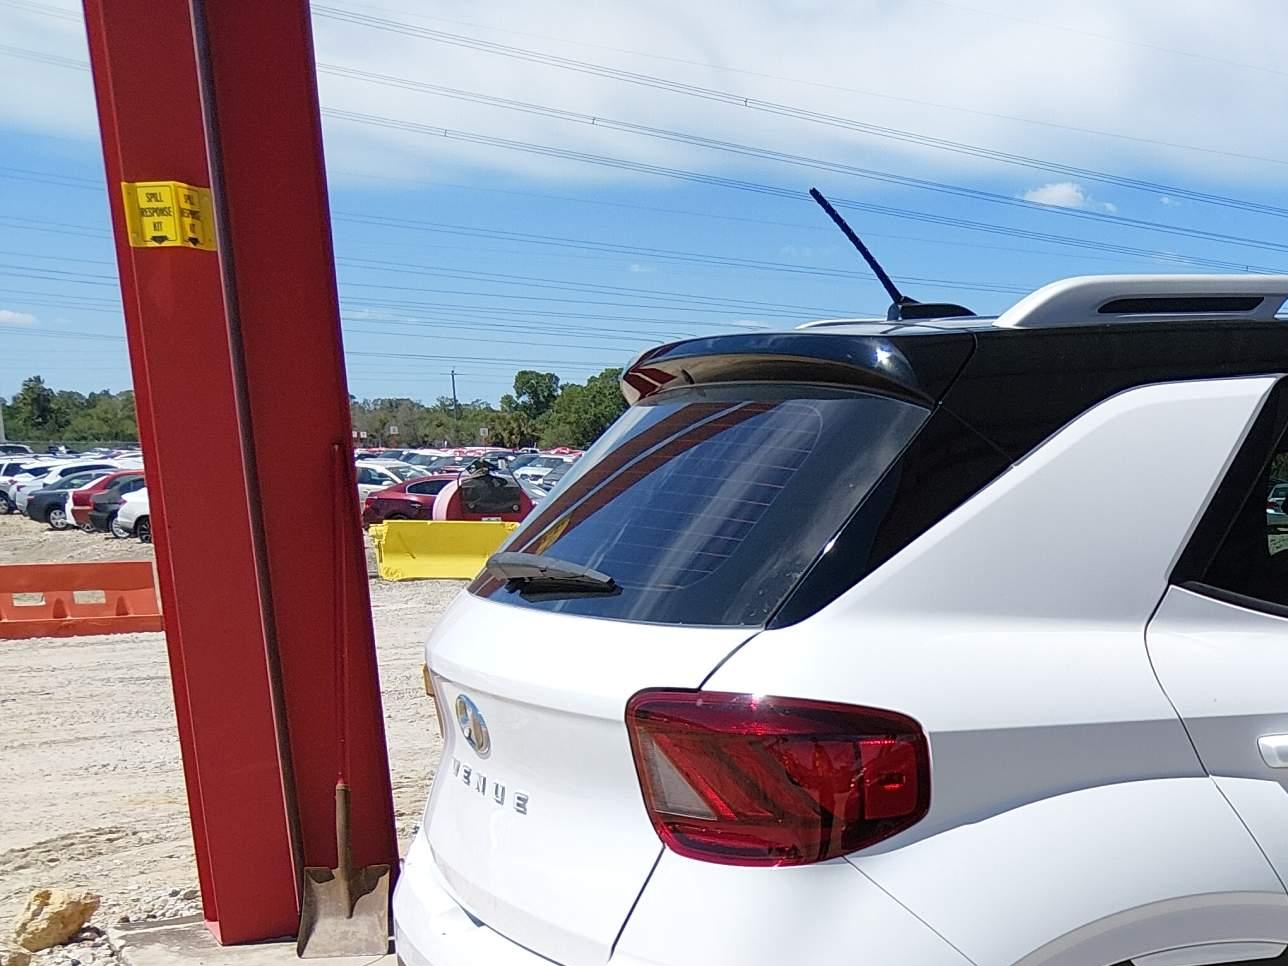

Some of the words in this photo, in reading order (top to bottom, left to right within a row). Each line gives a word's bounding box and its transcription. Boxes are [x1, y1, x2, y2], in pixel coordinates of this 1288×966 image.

[146, 193, 163, 202] SPILL
[141, 207, 172, 217] RESPONSE
[154, 222, 163, 231] KIT
[452, 756, 529, 816] VENUE
